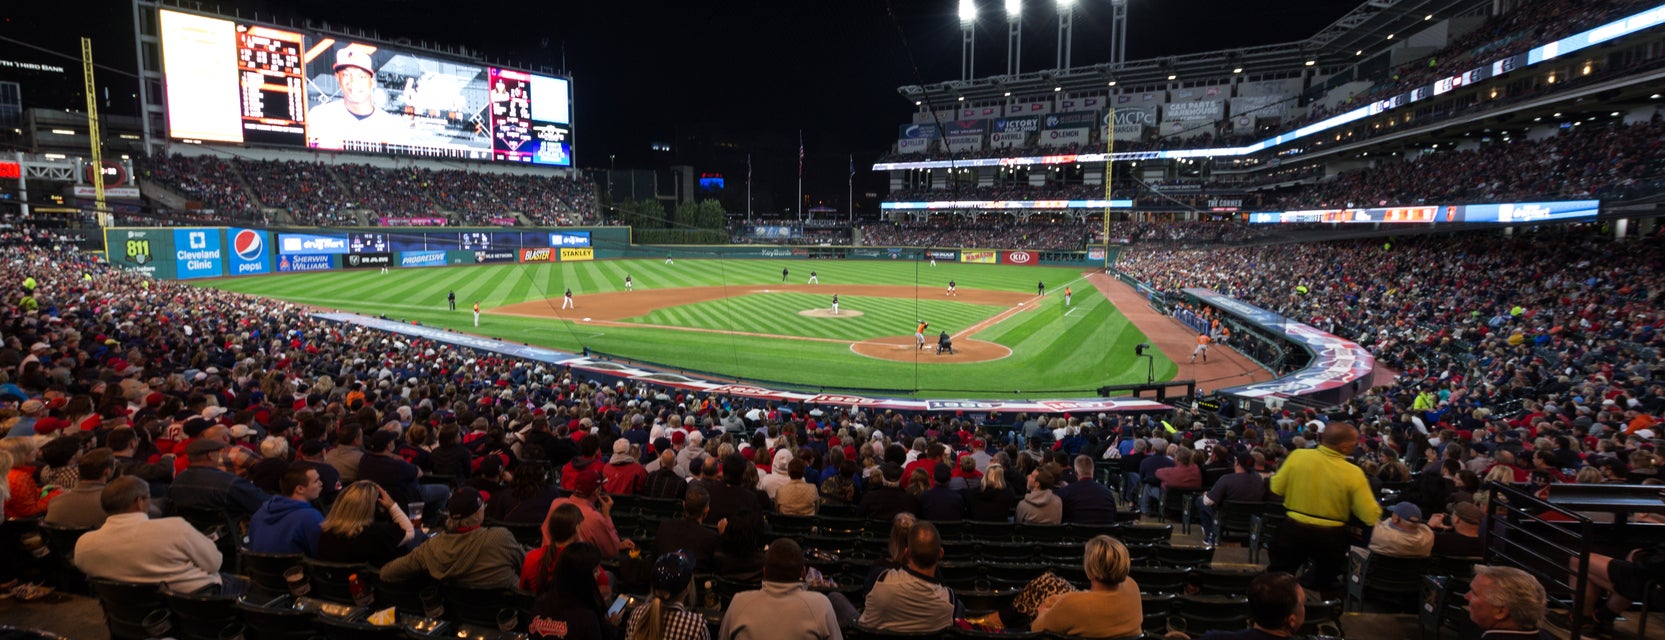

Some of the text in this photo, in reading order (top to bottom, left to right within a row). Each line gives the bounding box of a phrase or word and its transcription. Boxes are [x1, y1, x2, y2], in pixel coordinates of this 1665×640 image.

[15, 62, 40, 71] THIRD
[41, 64, 64, 73] BANK
[1189, 101, 1216, 109] PARTS
[1168, 107, 1217, 117] WAREHOUSE
[1059, 130, 1079, 138] LEMON
[1208, 199, 1242, 207] THE CORNER
[126, 239, 150, 257] 811
[761, 249, 791, 257] KeyBank
[177, 249, 220, 260] Cleveland
[402, 253, 445, 264] PROGRESSIVE
[524, 250, 551, 260] BLASTER
[1012, 254, 1027, 262] KIA
[187, 260, 212, 270] Clinic
[239, 262, 262, 272] pepsi
[292, 262, 329, 270] WILLIAMS
[169, 427, 180, 440] 12
[529, 615, 568, 637] Indians
